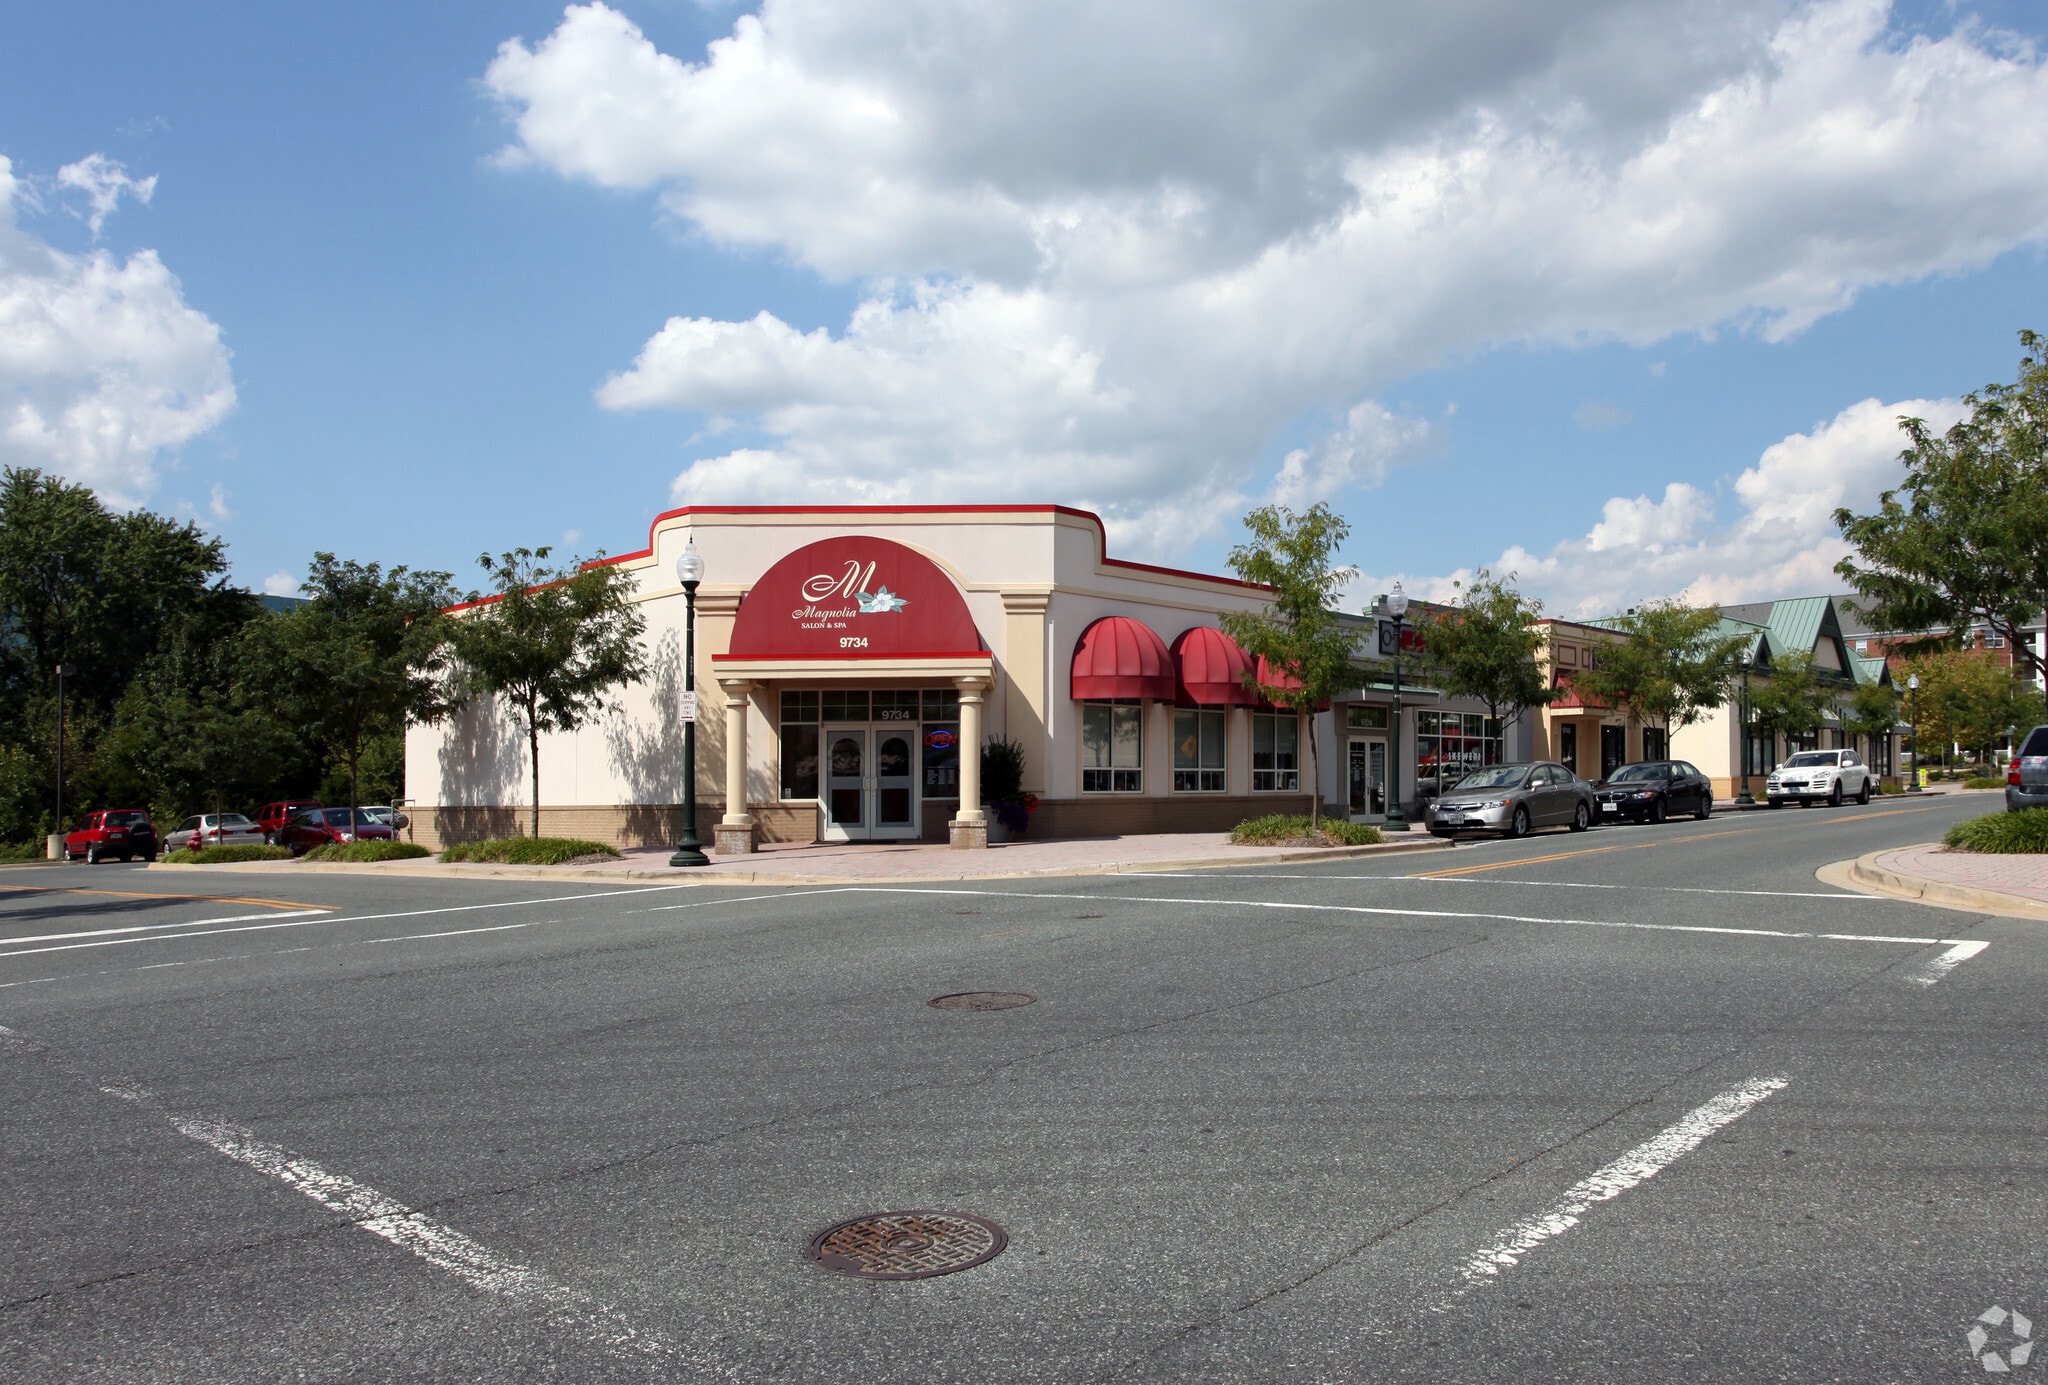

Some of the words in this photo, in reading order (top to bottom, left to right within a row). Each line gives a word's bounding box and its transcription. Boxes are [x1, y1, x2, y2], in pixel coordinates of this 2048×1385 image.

[792, 605, 857, 622] Magnolia
[840, 637, 869, 648] 9734
[881, 710, 910, 720] 9734
[924, 733, 957, 746] OPEN
